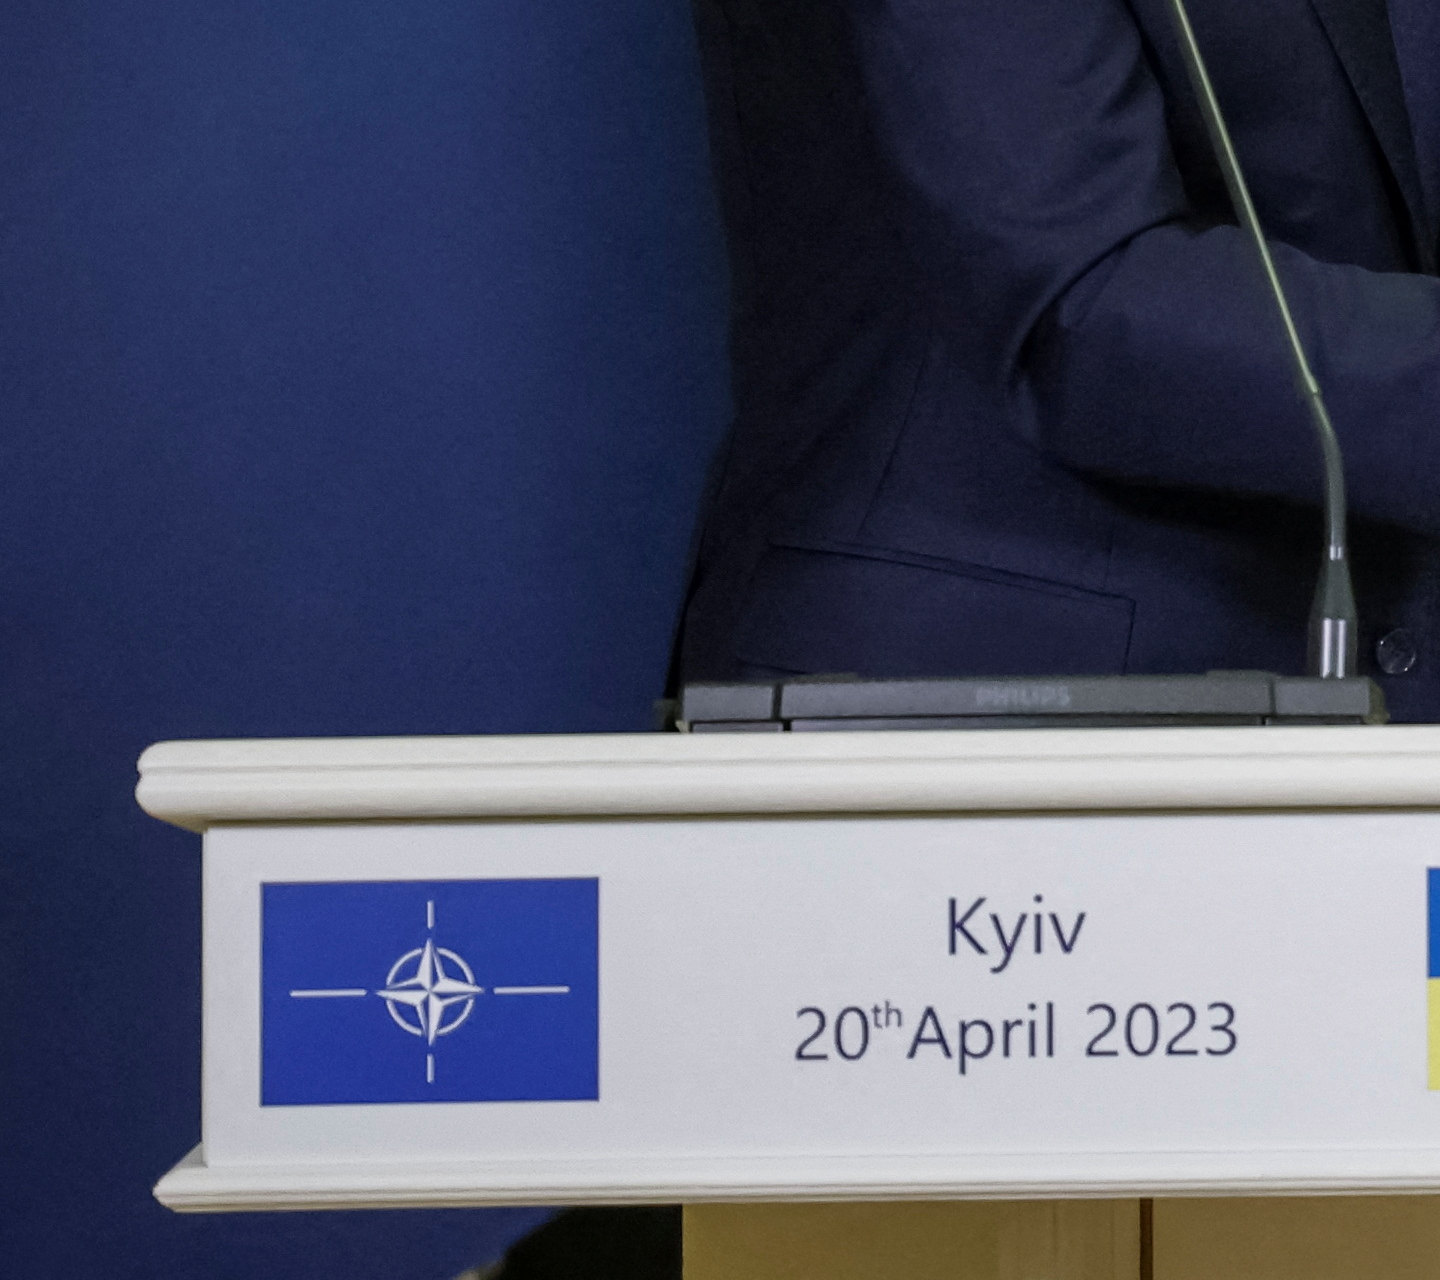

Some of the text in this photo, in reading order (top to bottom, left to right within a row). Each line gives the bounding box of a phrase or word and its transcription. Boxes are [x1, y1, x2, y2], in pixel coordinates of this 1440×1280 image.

[947, 893, 1087, 975] Kyiv
[794, 1000, 1239, 1077] 20th April 2023
